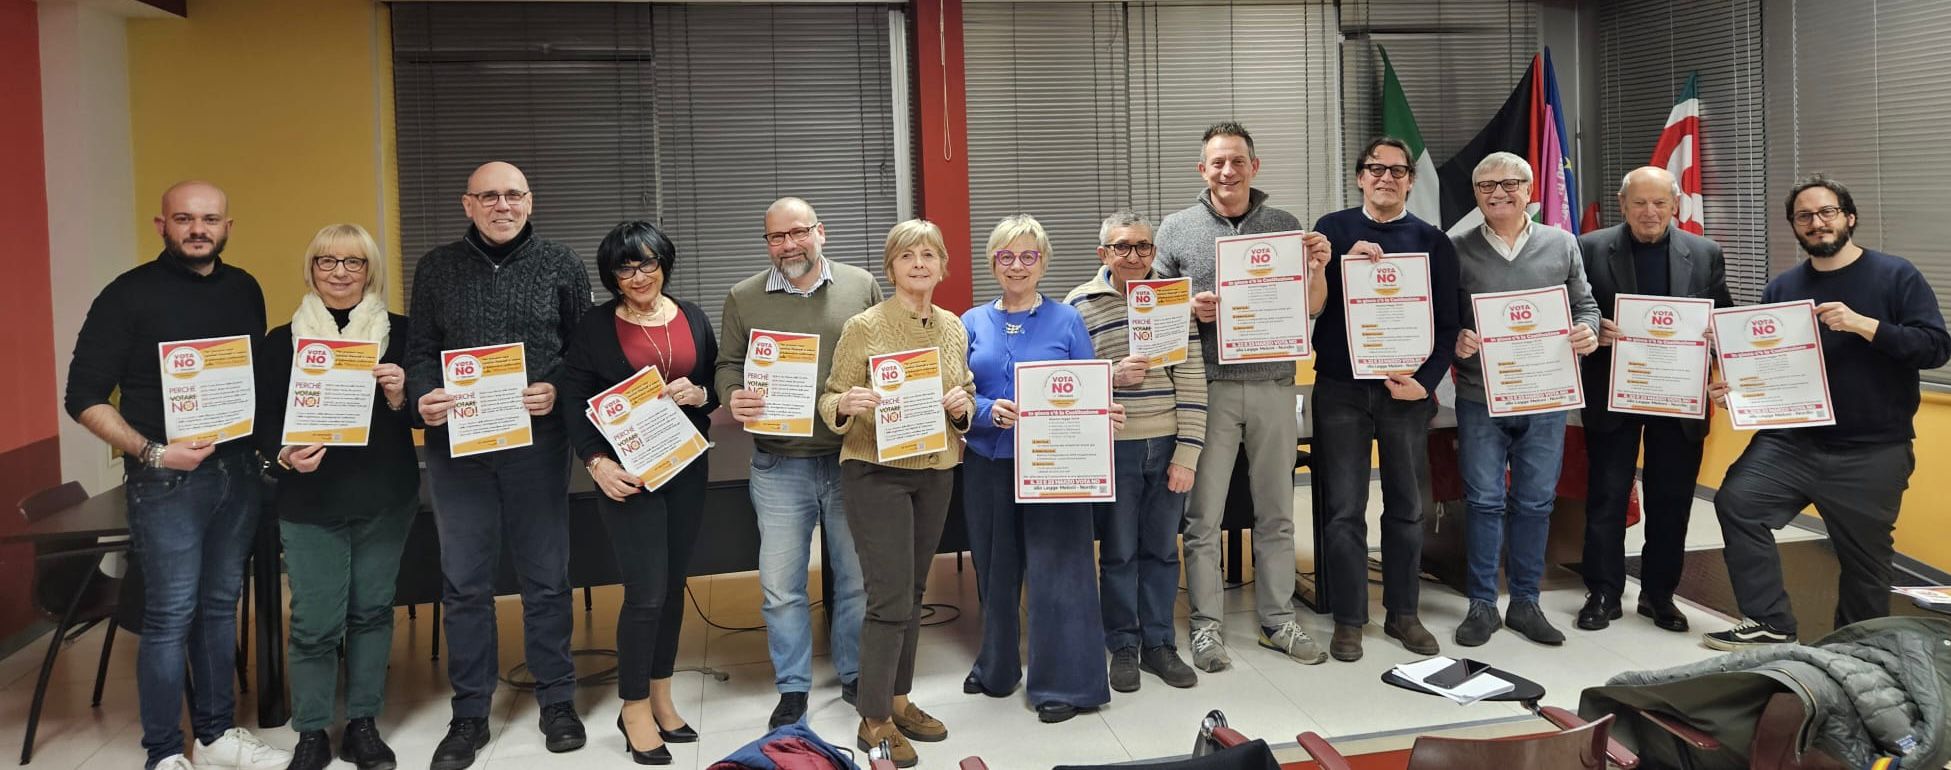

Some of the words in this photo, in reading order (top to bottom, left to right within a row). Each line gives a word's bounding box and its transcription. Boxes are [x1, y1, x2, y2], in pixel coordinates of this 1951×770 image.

[1251, 254, 1270, 264] NO
[1377, 274, 1396, 284] NO
[1136, 295, 1151, 303] NO
[1510, 311, 1532, 321] NO
[1652, 316, 1673, 326] NO
[1752, 325, 1776, 336] NO
[1134, 331, 1153, 341] NO!
[755, 348, 772, 356] NO
[174, 359, 195, 368] NO
[455, 366, 474, 375] NO
[882, 371, 898, 380] NO
[748, 380, 769, 388] VOTARE
[1052, 383, 1074, 393] NO
[455, 391, 475, 400] ERCHÉ
[172, 400, 198, 413] NO!
[294, 396, 320, 407] NO!
[604, 398, 621, 409] VOTA
[454, 406, 478, 419] NO!
[606, 403, 624, 417] NO
[881, 411, 902, 424] NO!
[617, 433, 638, 447] VOTARE
[621, 438, 645, 456] NO!
